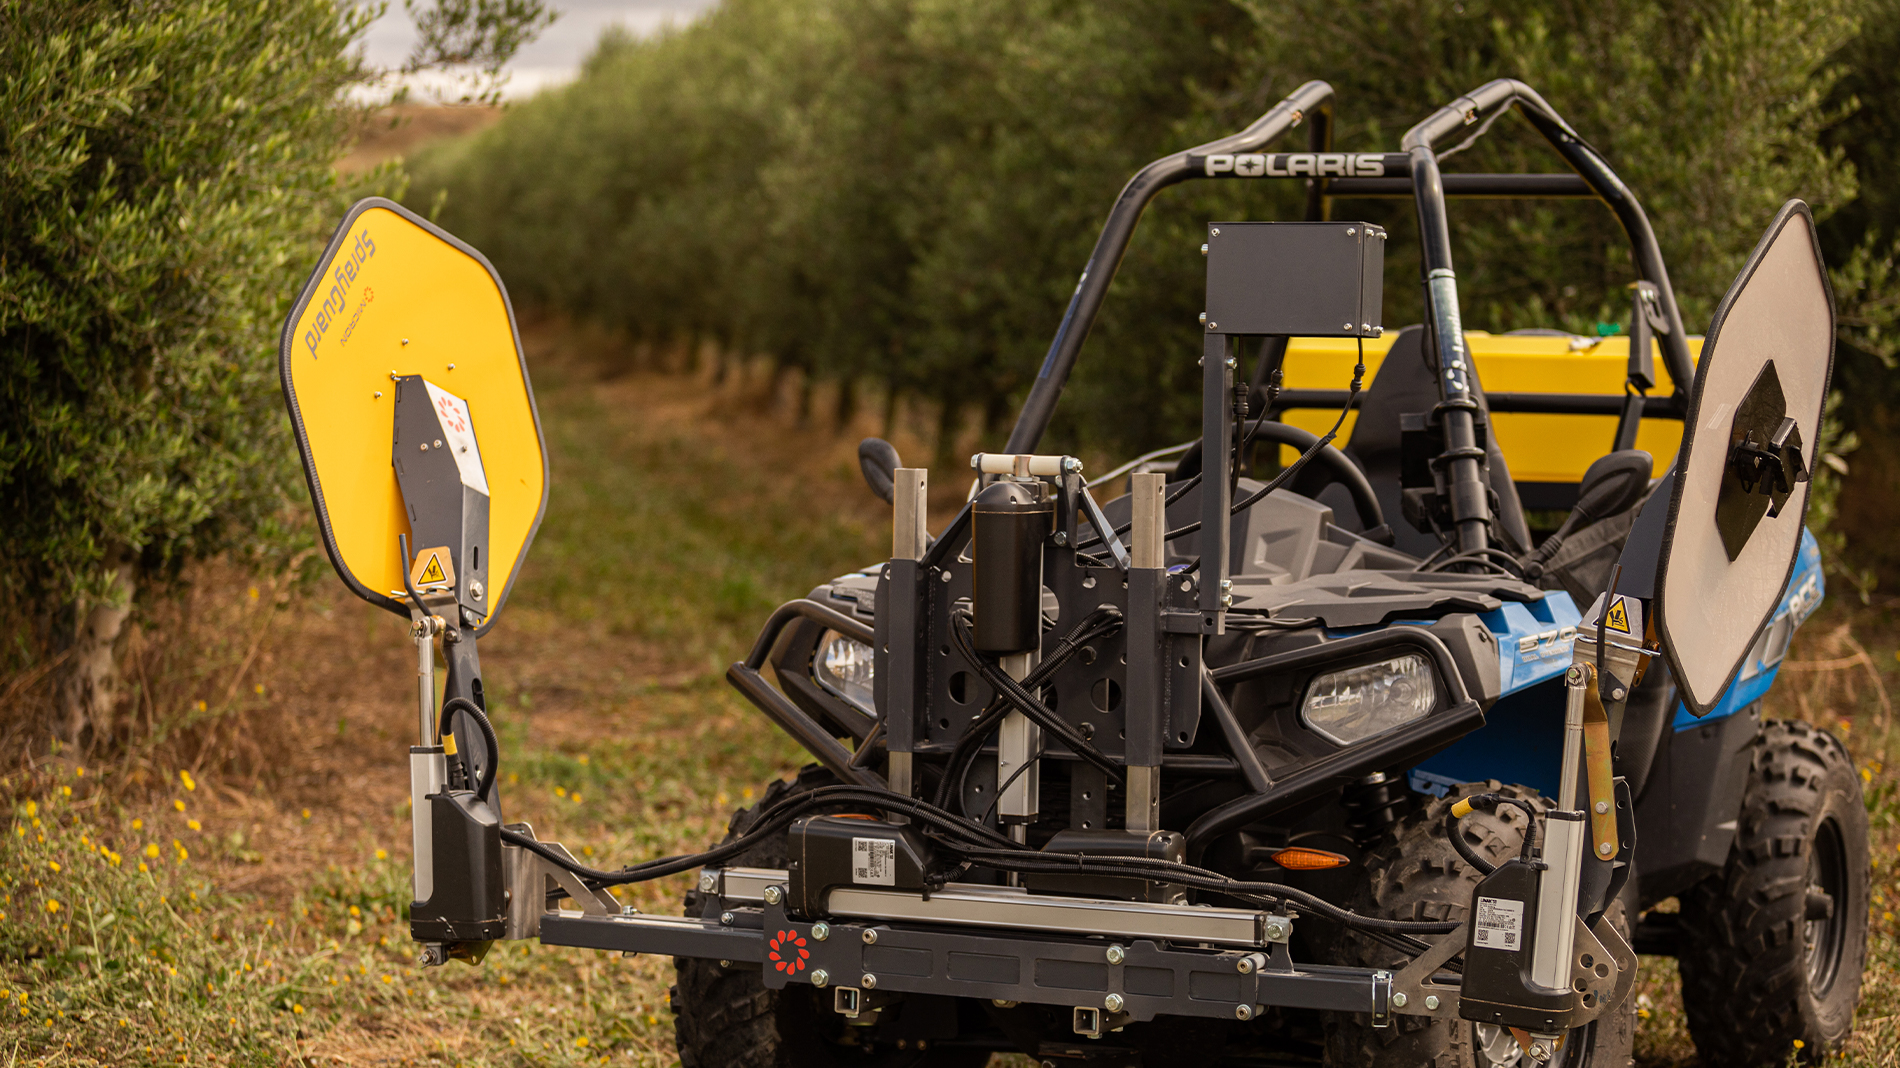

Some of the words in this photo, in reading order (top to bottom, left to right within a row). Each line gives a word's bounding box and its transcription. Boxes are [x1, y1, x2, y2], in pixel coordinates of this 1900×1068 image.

[1205, 154, 1385, 176] POLARIS
[304, 228, 376, 360] SprayGuard
[1789, 573, 1822, 627] ACE
[1519, 626, 1577, 653] 570
